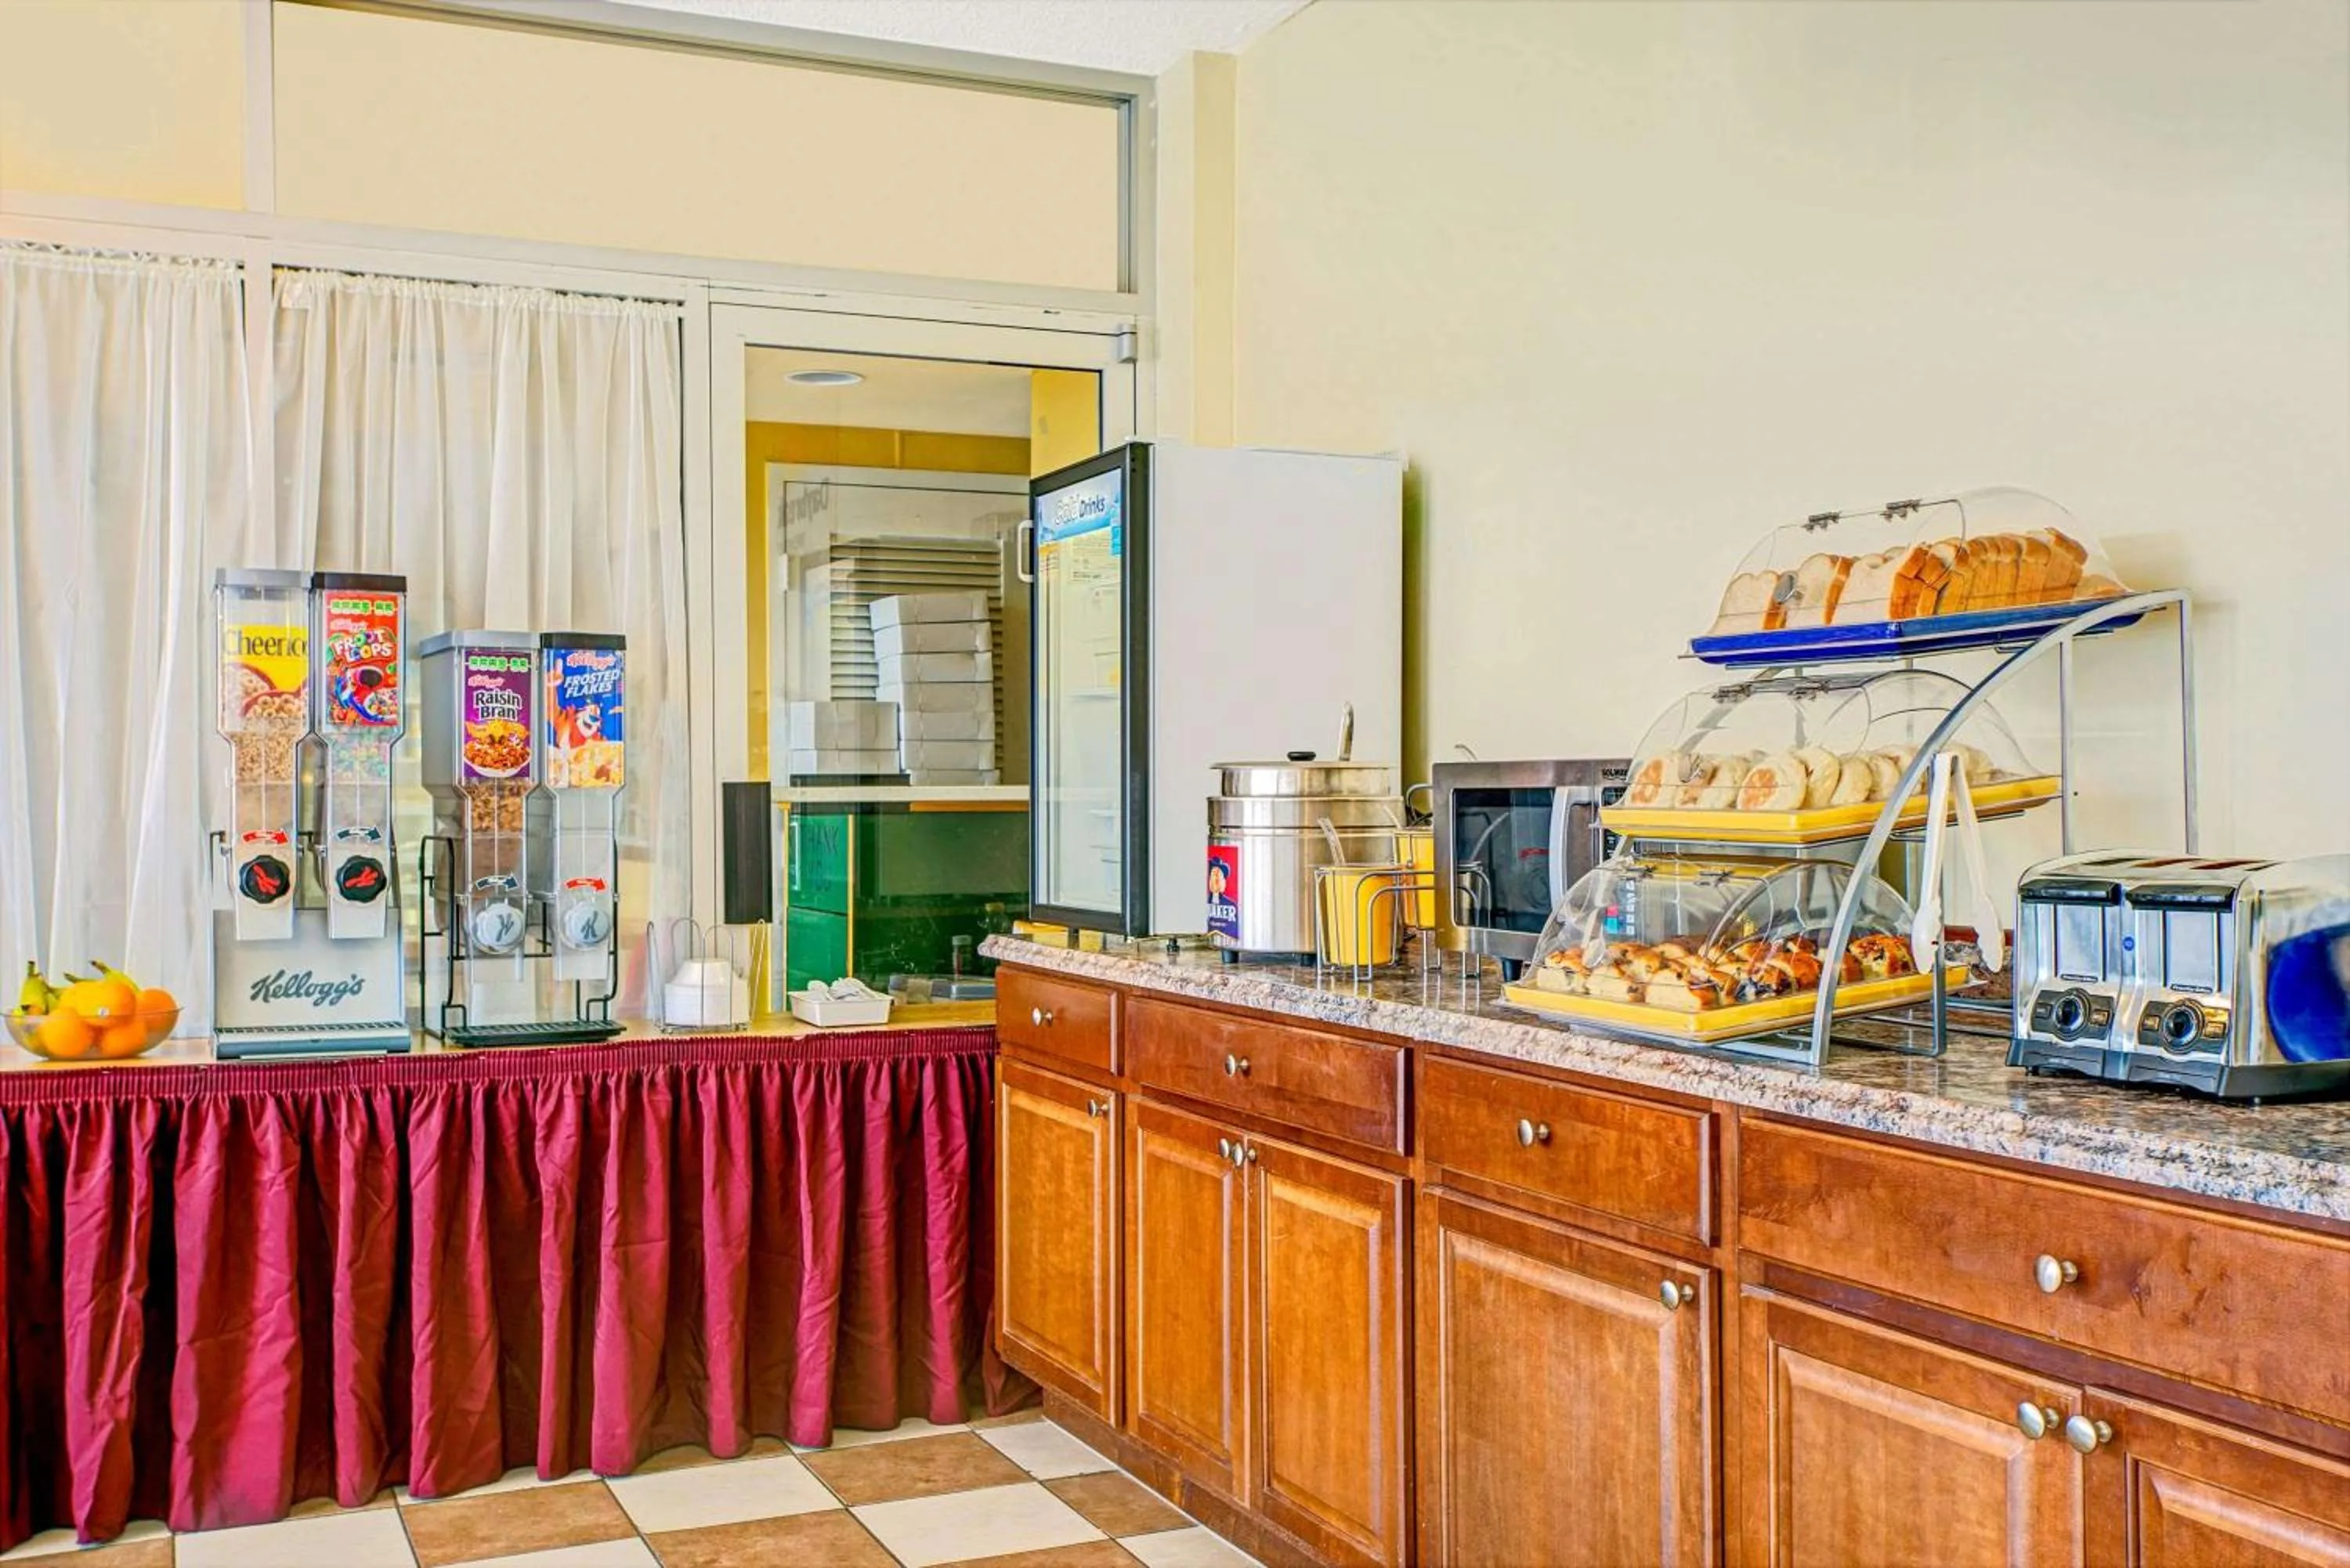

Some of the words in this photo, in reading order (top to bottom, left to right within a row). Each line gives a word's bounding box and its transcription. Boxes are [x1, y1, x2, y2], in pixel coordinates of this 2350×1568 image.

[1079, 495, 1105, 518] Drinks
[564, 670, 620, 688] FROSTED
[566, 680, 612, 699] FLAKES
[475, 690, 521, 709] Raisin
[480, 706, 515, 720] Bran
[250, 969, 366, 1006] Kellogg's
